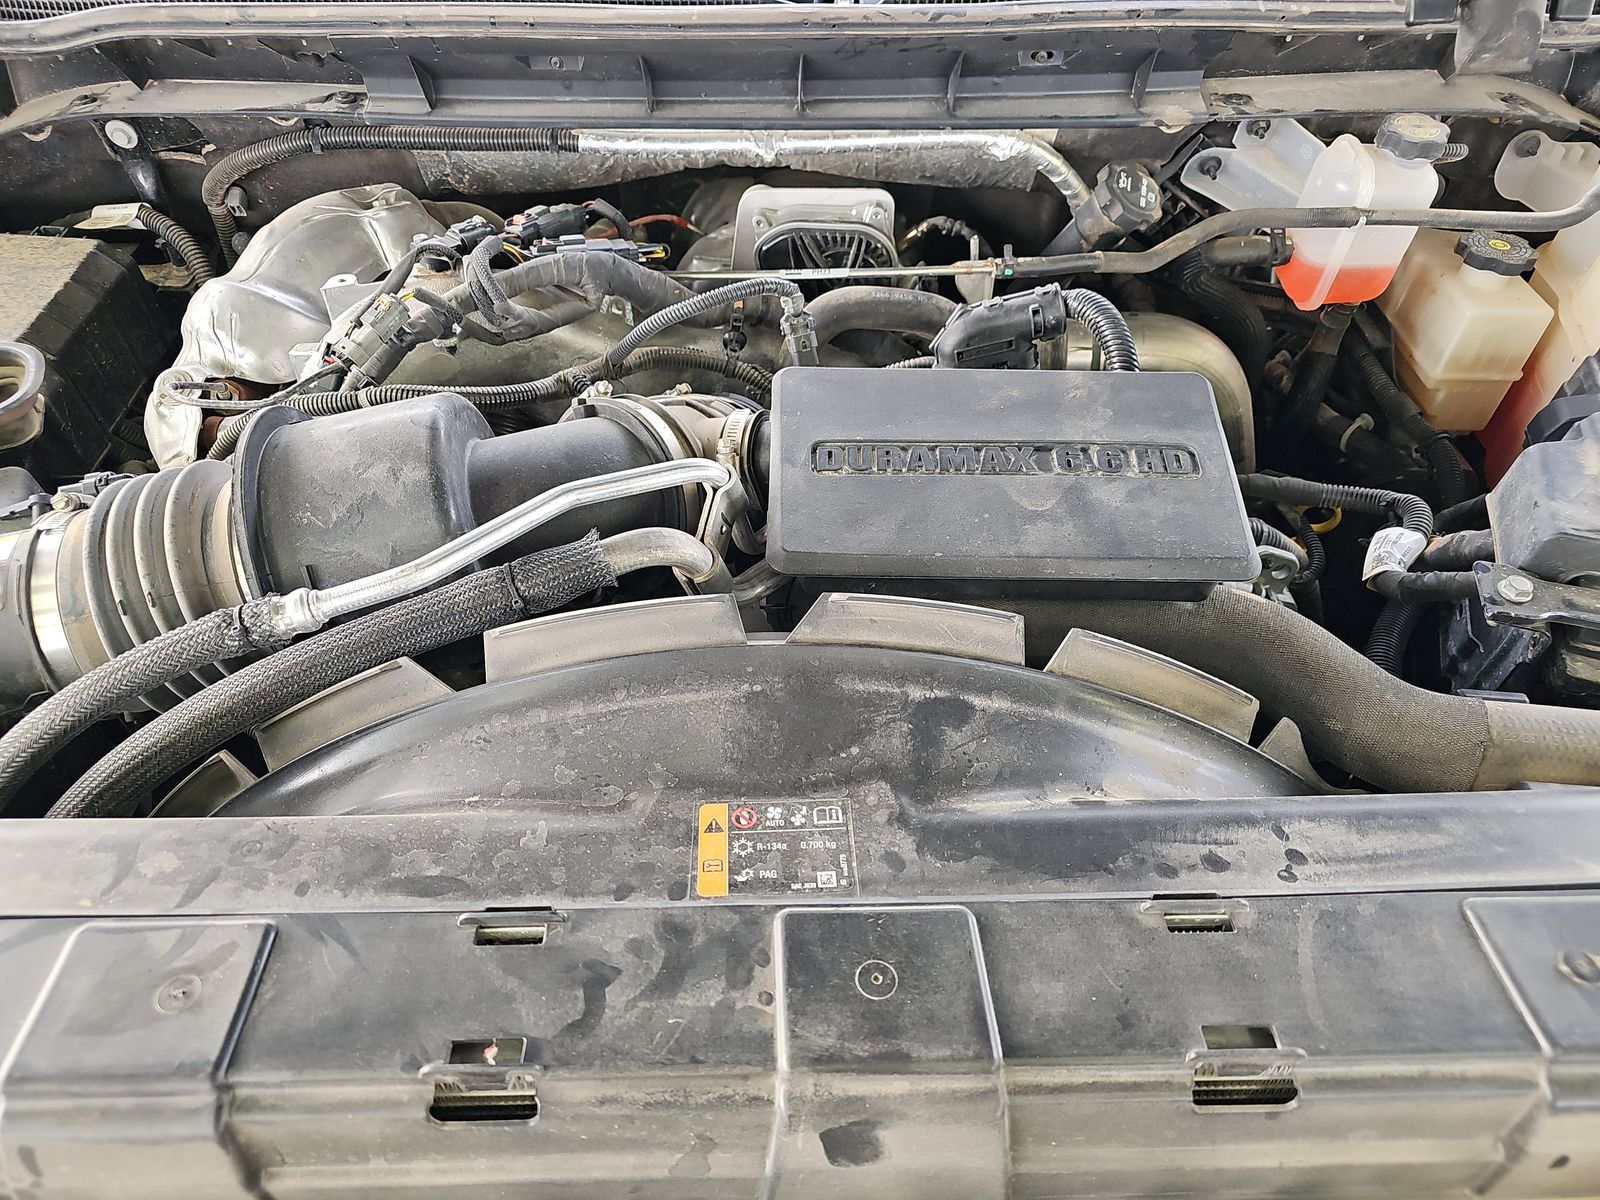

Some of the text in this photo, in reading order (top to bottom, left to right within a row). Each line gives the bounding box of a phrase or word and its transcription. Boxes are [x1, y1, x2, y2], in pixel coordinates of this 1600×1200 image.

[815, 445, 1193, 475] DURAMAX 6.6 HD
[765, 819, 785, 827] AUTO
[757, 842, 788, 851] R-134a
[800, 840, 837, 850] 0.700 kg
[759, 869, 778, 879] PAG
